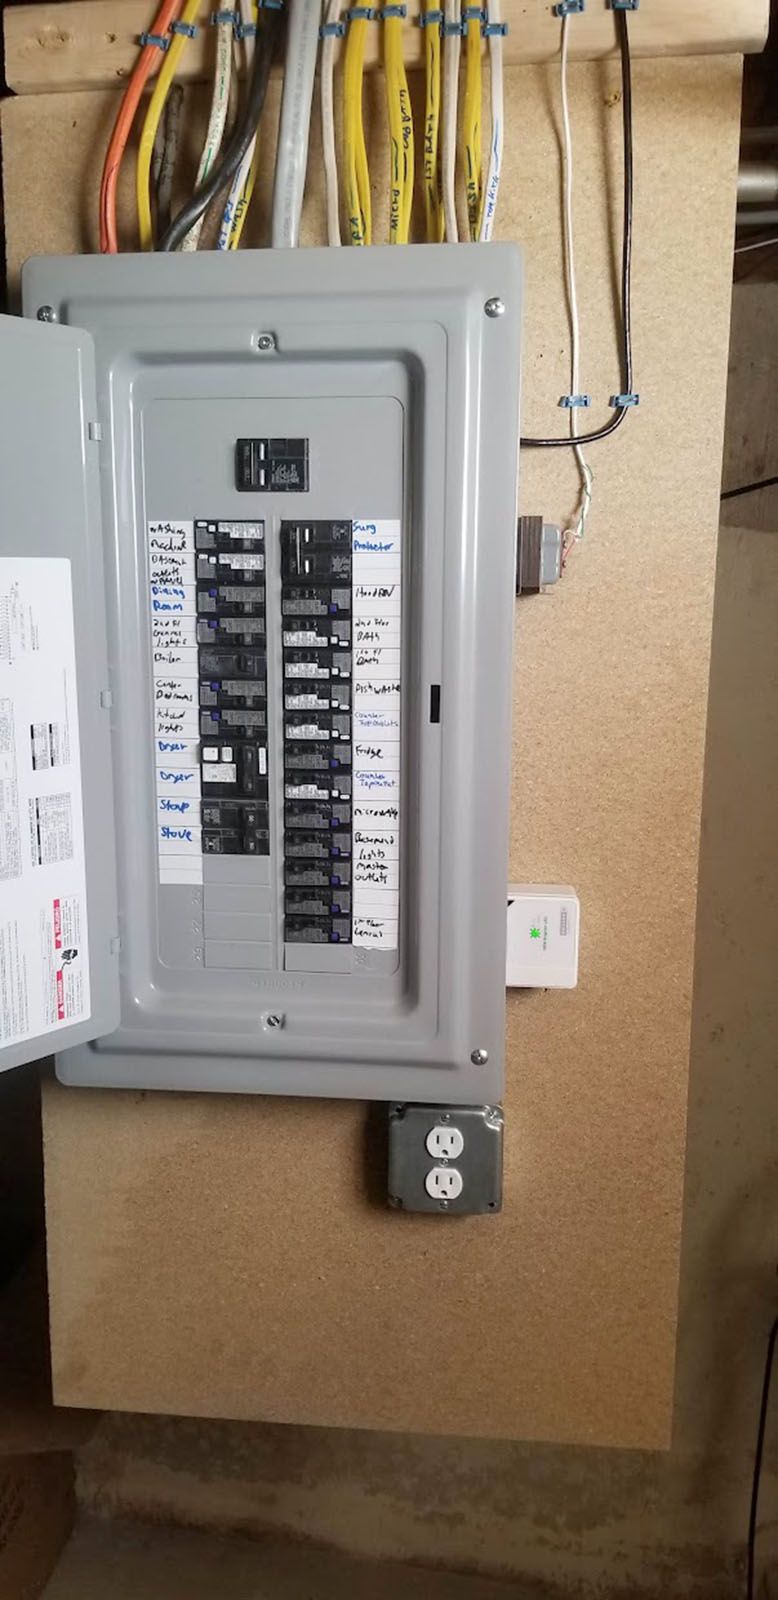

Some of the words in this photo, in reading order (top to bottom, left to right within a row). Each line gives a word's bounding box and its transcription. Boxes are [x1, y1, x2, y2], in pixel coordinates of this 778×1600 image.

[355, 745, 384, 759] Fridge
[160, 771, 194, 784] Dryer
[161, 827, 192, 842] Stove
